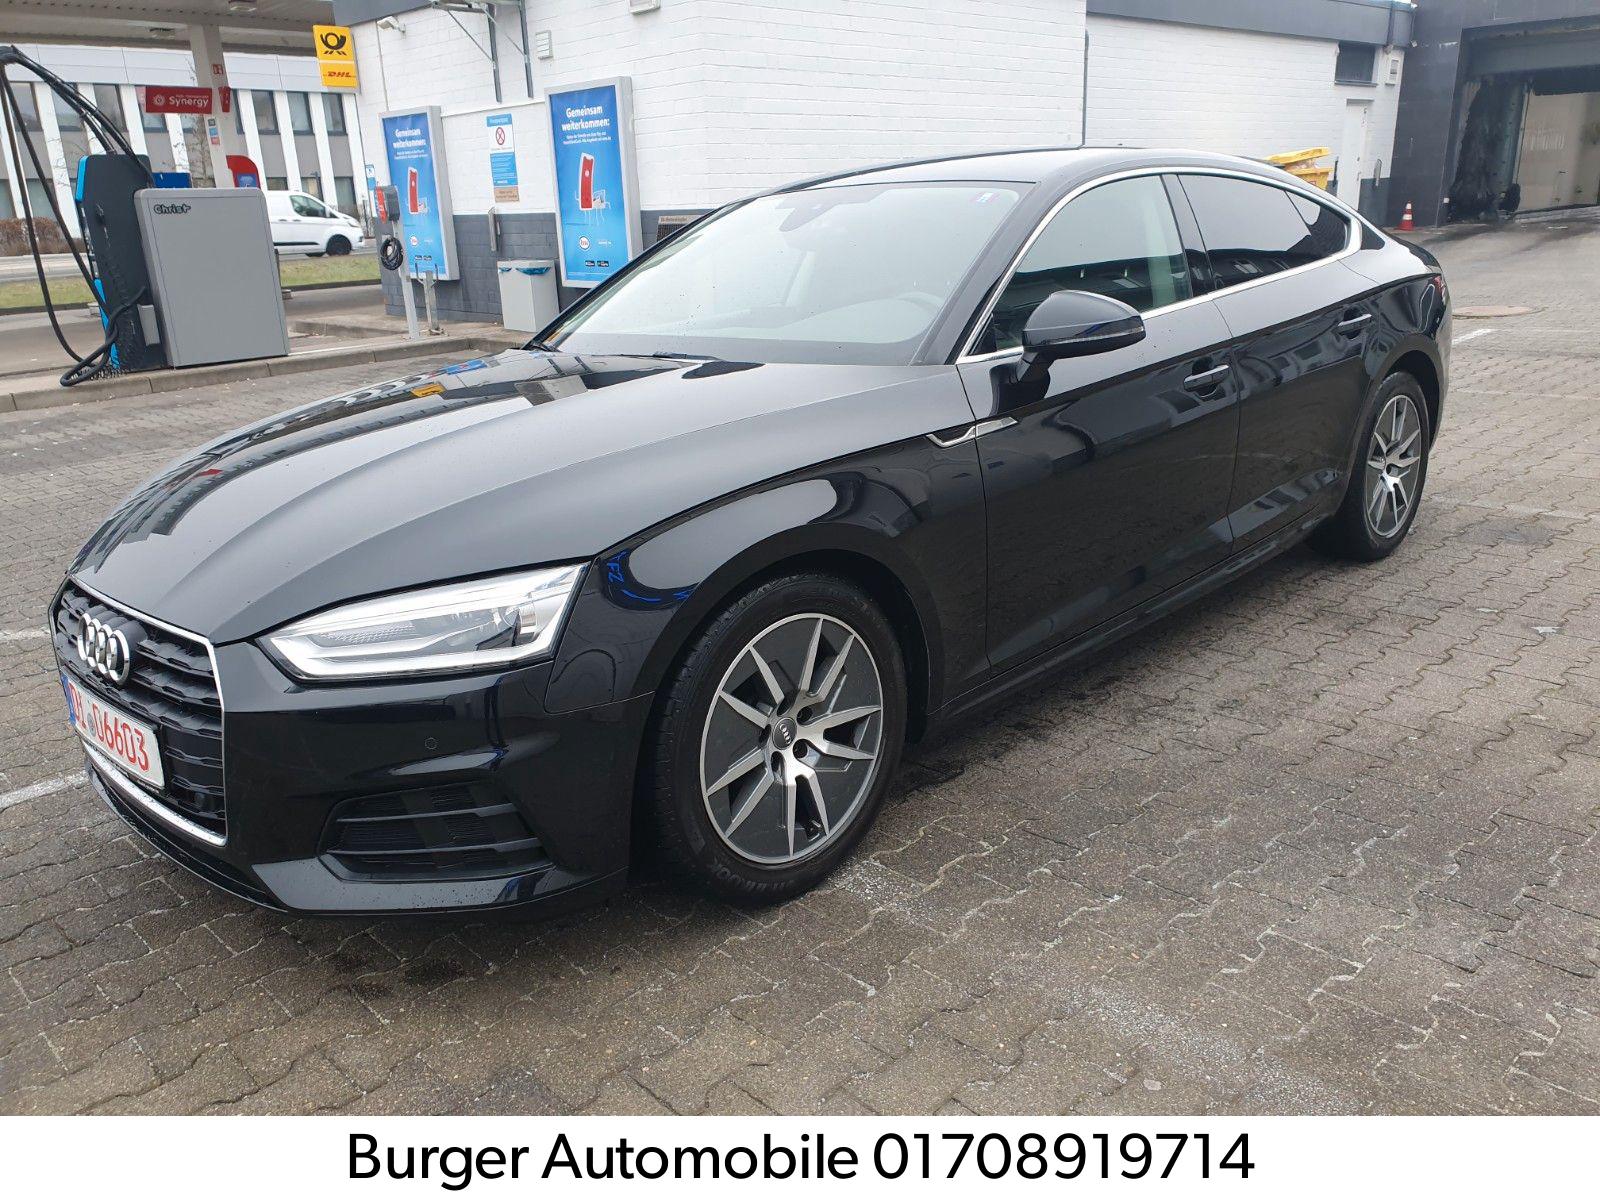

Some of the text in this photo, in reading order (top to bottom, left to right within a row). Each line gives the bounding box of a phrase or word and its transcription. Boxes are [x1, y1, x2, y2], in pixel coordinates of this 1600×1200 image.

[168, 95, 209, 107] Synergy
[565, 105, 603, 118] Gemeinsam
[561, 118, 610, 131] weiterkommen:
[153, 203, 192, 215] Christ
[92, 702, 149, 772] 06603
